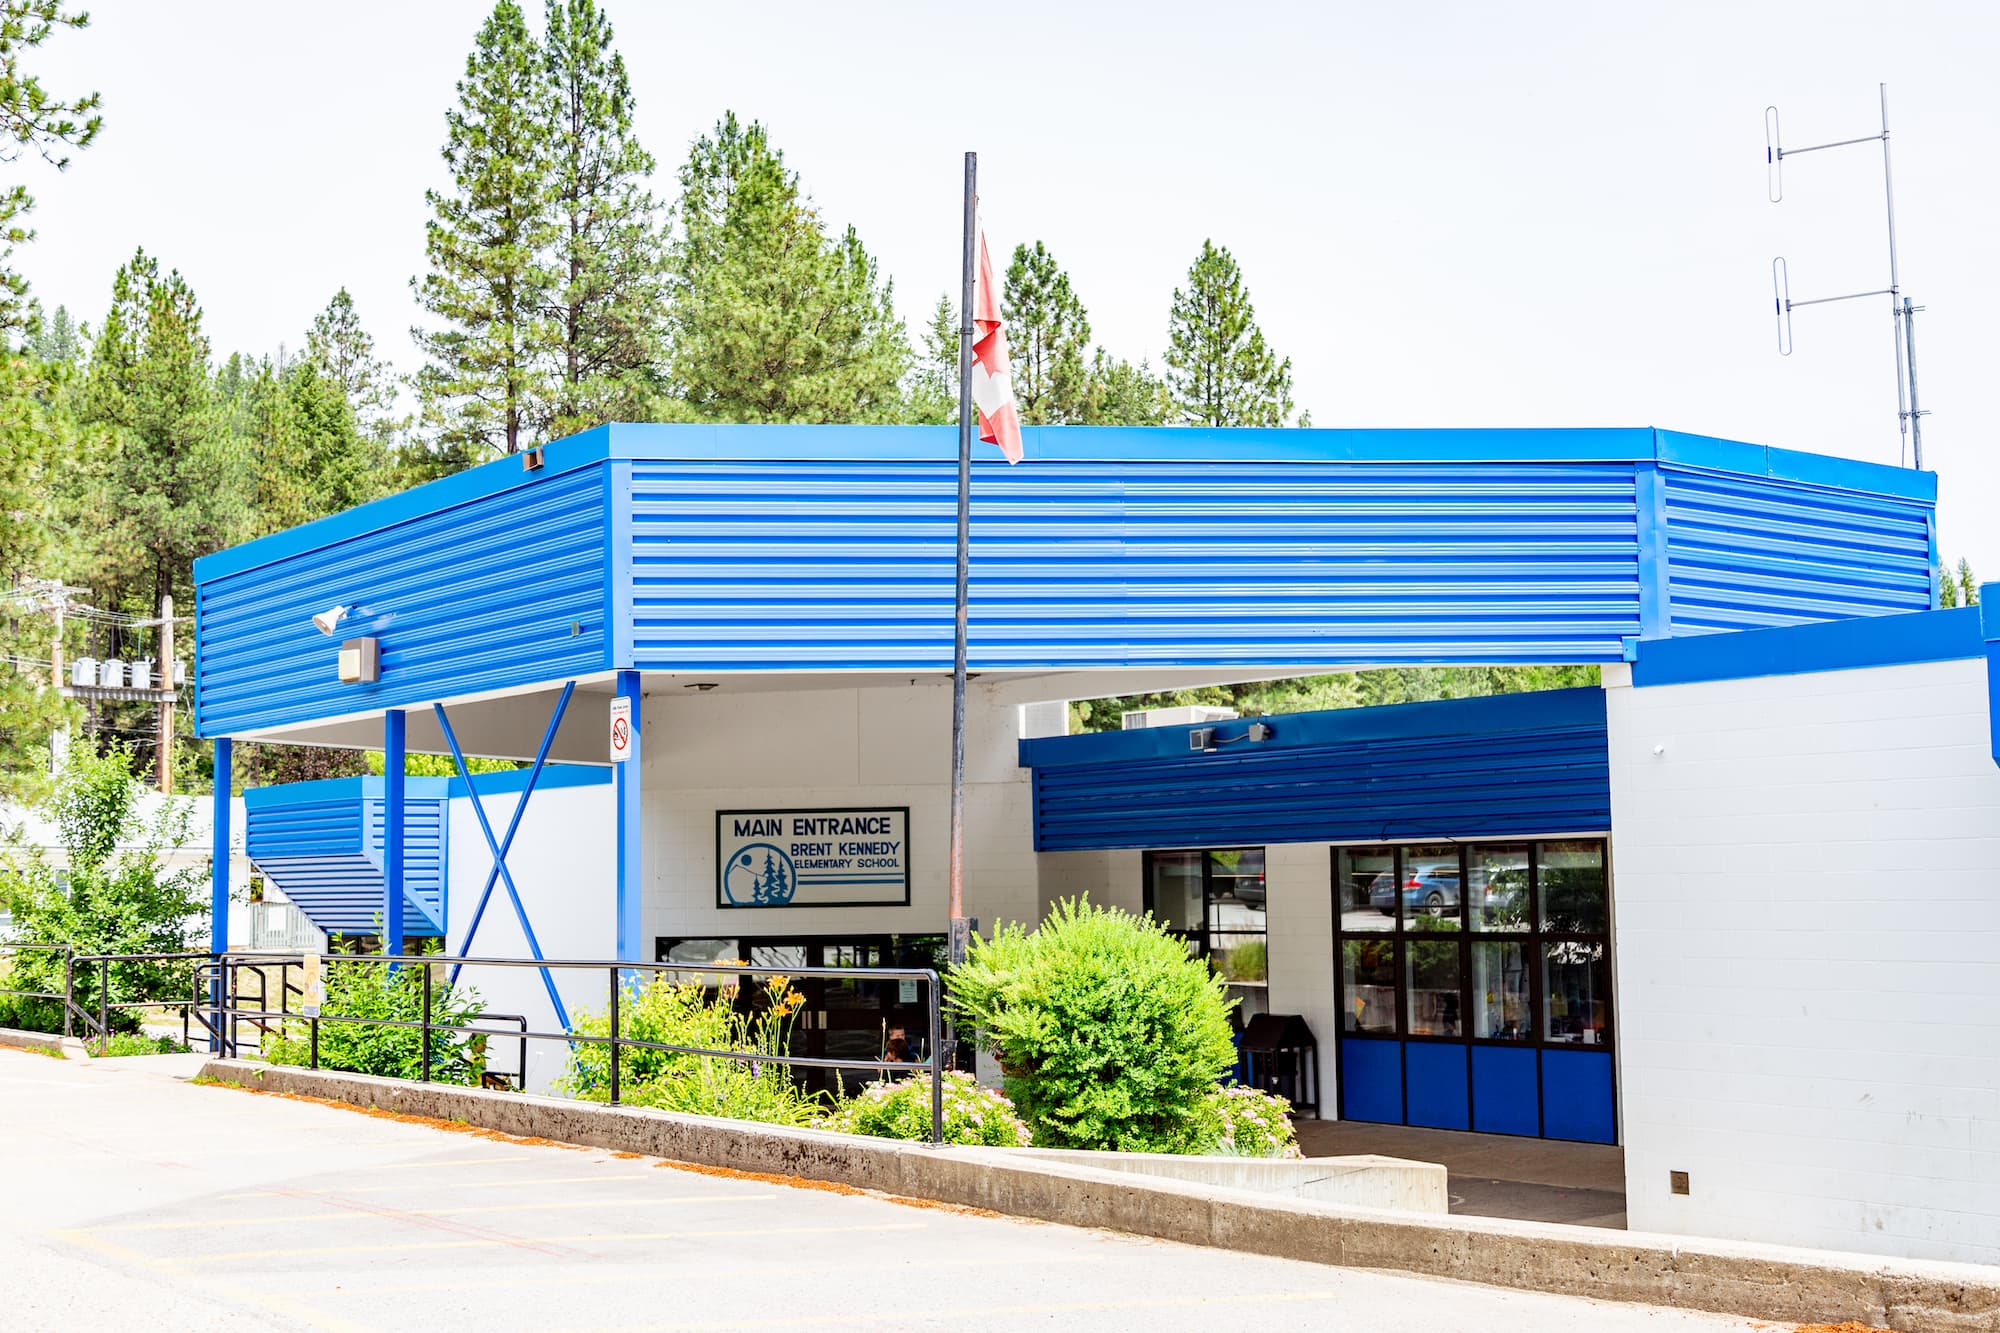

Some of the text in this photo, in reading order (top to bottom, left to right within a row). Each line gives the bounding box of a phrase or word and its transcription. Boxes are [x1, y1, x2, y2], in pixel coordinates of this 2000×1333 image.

[734, 817, 891, 837] MAIN ENTRANCE
[791, 841, 900, 856] BRENT KENNEDY
[794, 858, 900, 869] ELEMENTARY SCHOOL
